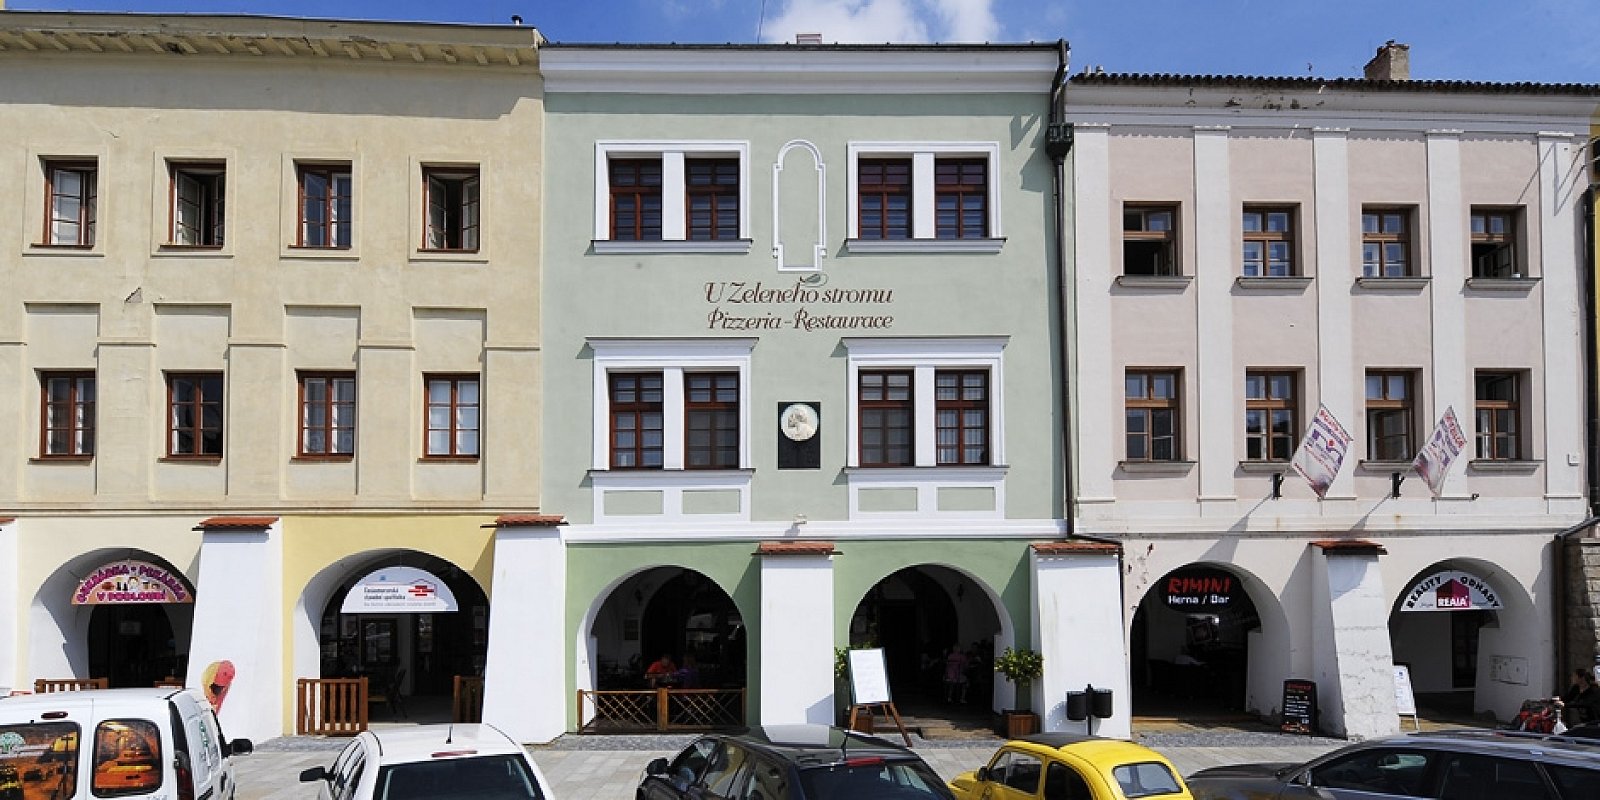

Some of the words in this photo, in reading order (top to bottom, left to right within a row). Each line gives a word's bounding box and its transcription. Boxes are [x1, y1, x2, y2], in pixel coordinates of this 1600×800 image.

[705, 282, 727, 303] U
[822, 286, 894, 304] stromu
[1167, 577, 1232, 594] RIMINI
[1406, 576, 1441, 608] REALITY
[1460, 576, 1500, 607] ODHADY
[1167, 595, 1199, 605] Herna
[1210, 594, 1230, 605] Bar
